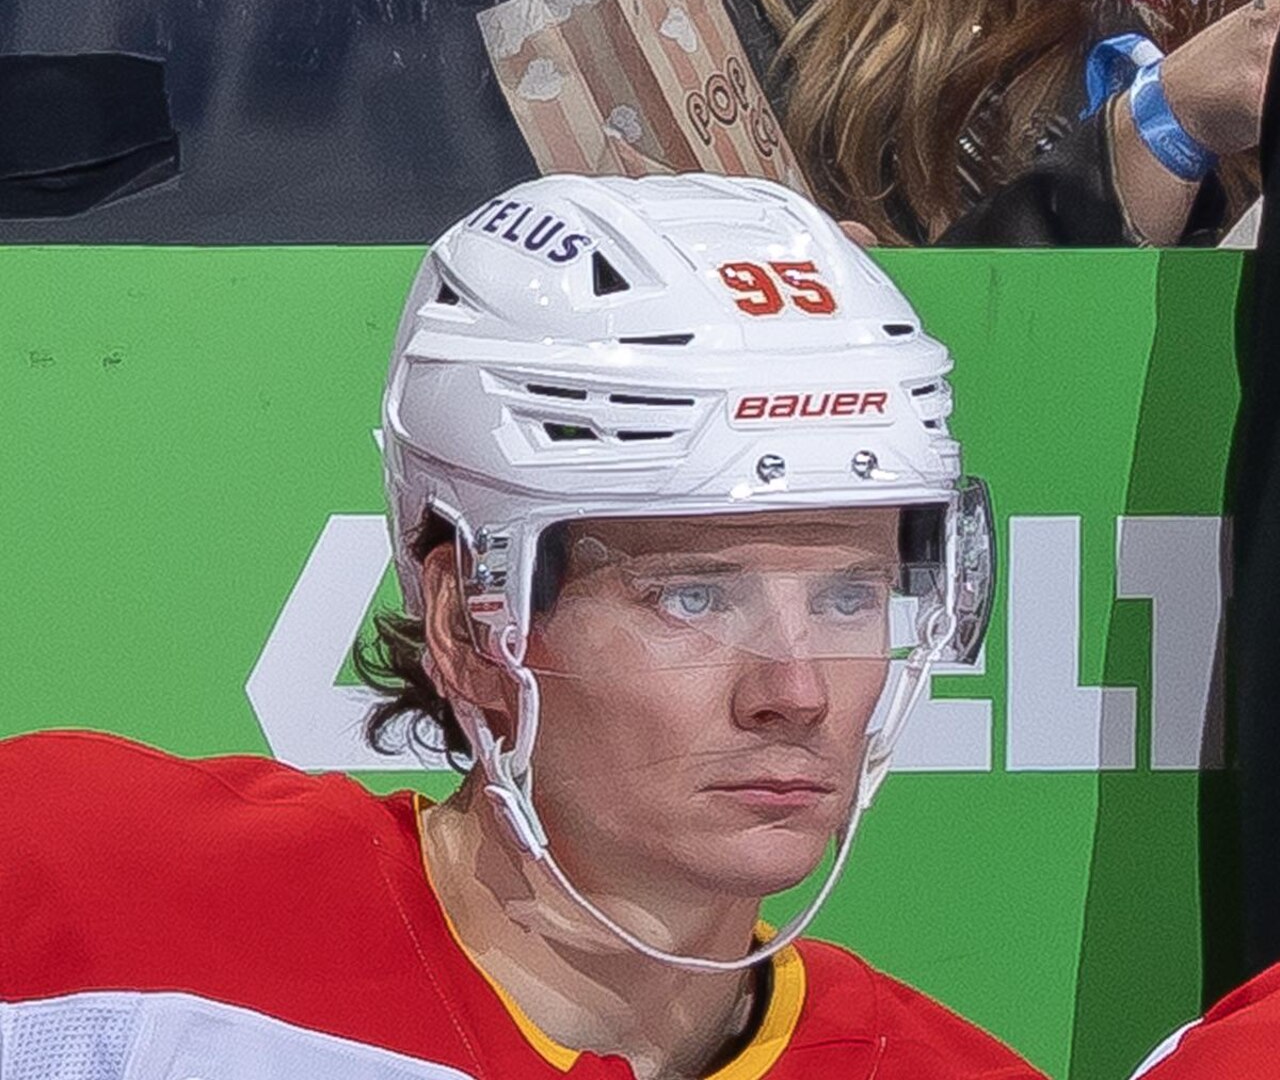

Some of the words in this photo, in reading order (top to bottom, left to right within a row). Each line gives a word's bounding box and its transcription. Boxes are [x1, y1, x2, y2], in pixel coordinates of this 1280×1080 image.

[686, 55, 750, 146] POP
[467, 198, 593, 262] TELUS
[717, 260, 839, 317] 95
